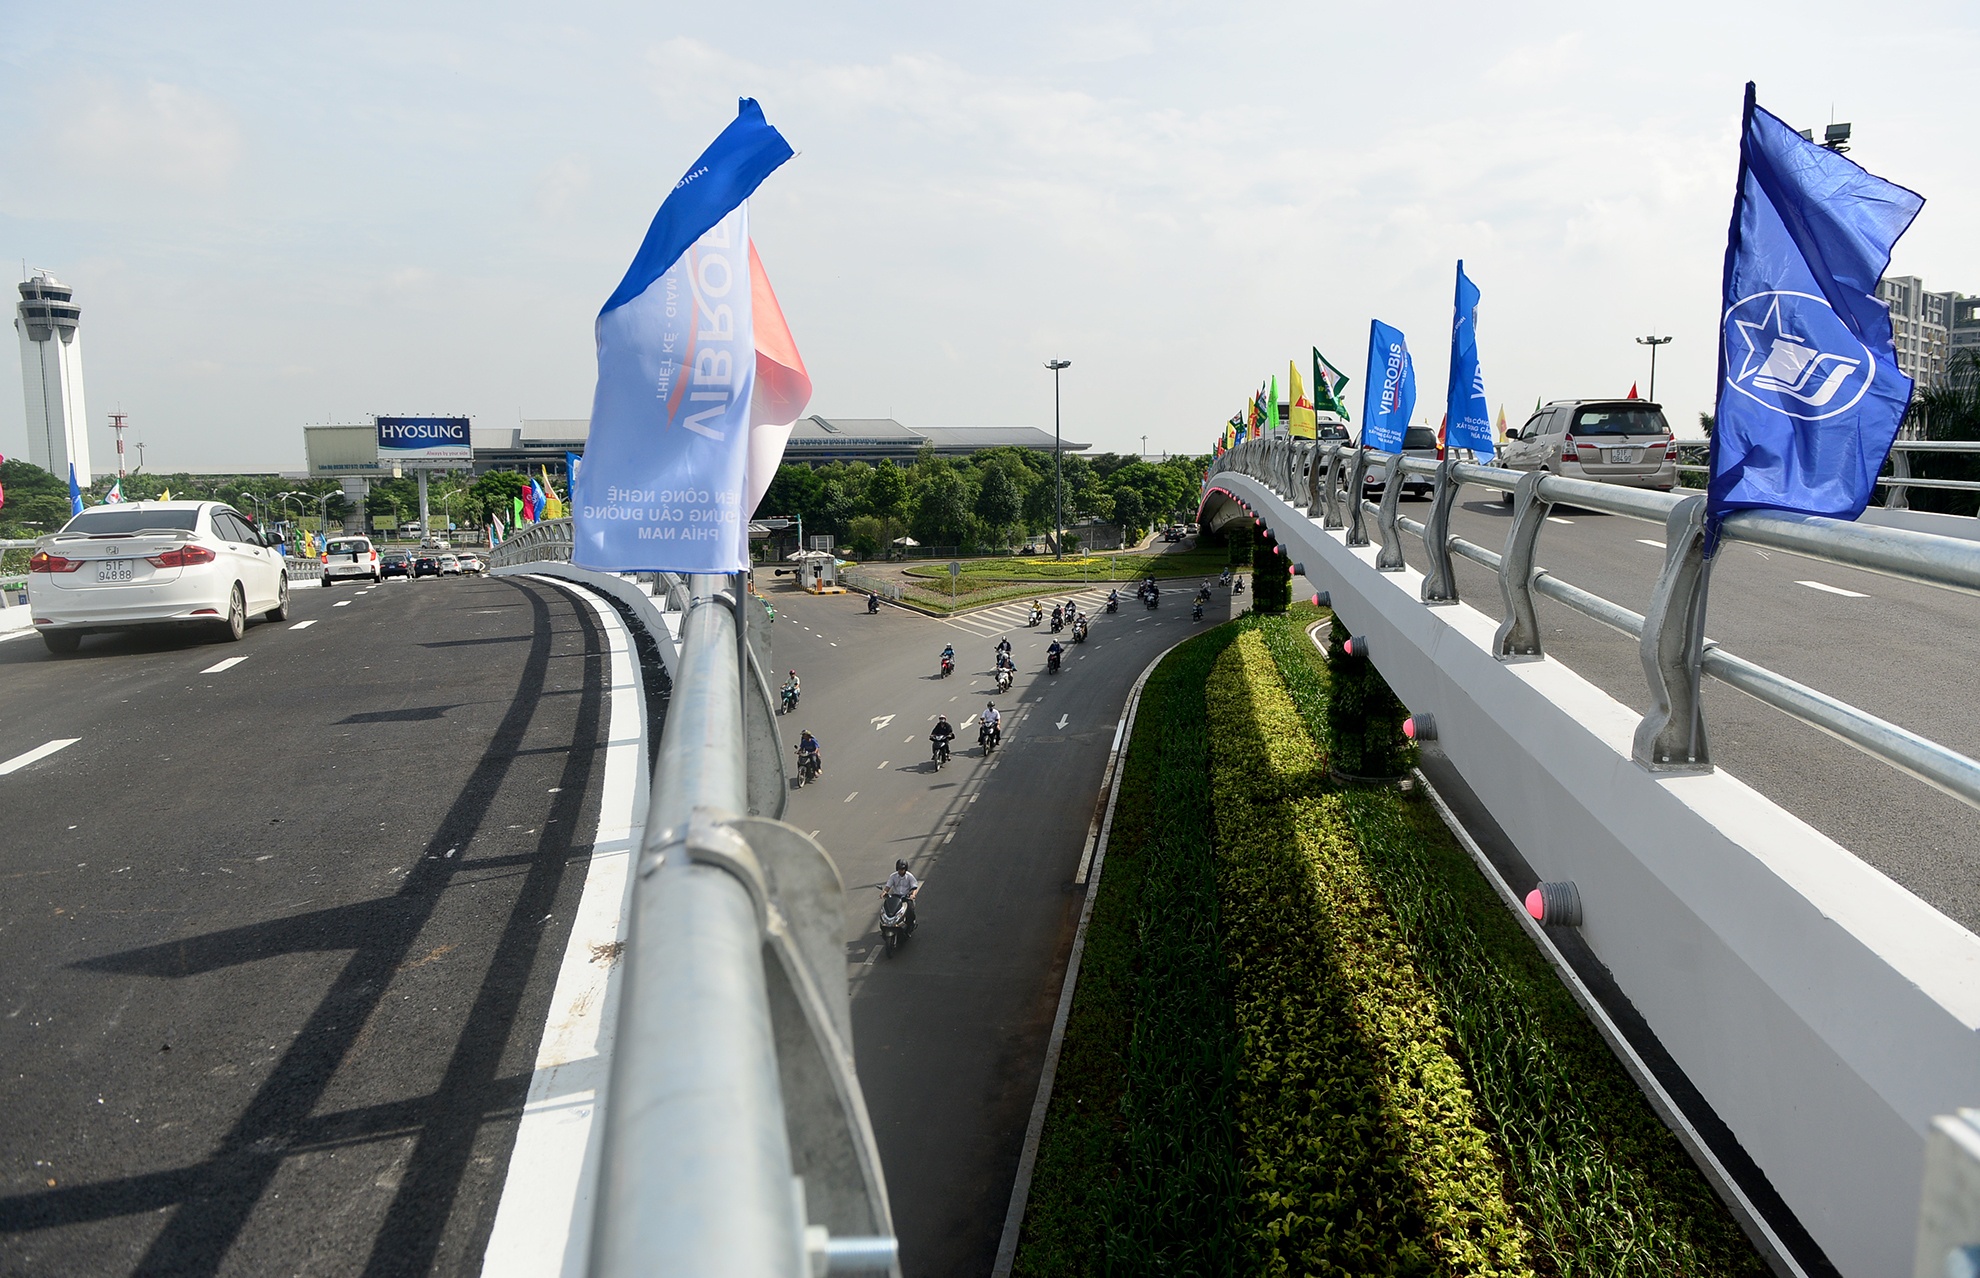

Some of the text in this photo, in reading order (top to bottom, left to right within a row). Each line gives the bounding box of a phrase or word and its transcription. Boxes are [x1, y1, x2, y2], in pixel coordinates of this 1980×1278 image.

[1379, 342, 1402, 415] VIBROBIS
[381, 425, 463, 438] HYOSUNG
[105, 560, 123, 570] 51F
[99, 570, 132, 581] 948.88
